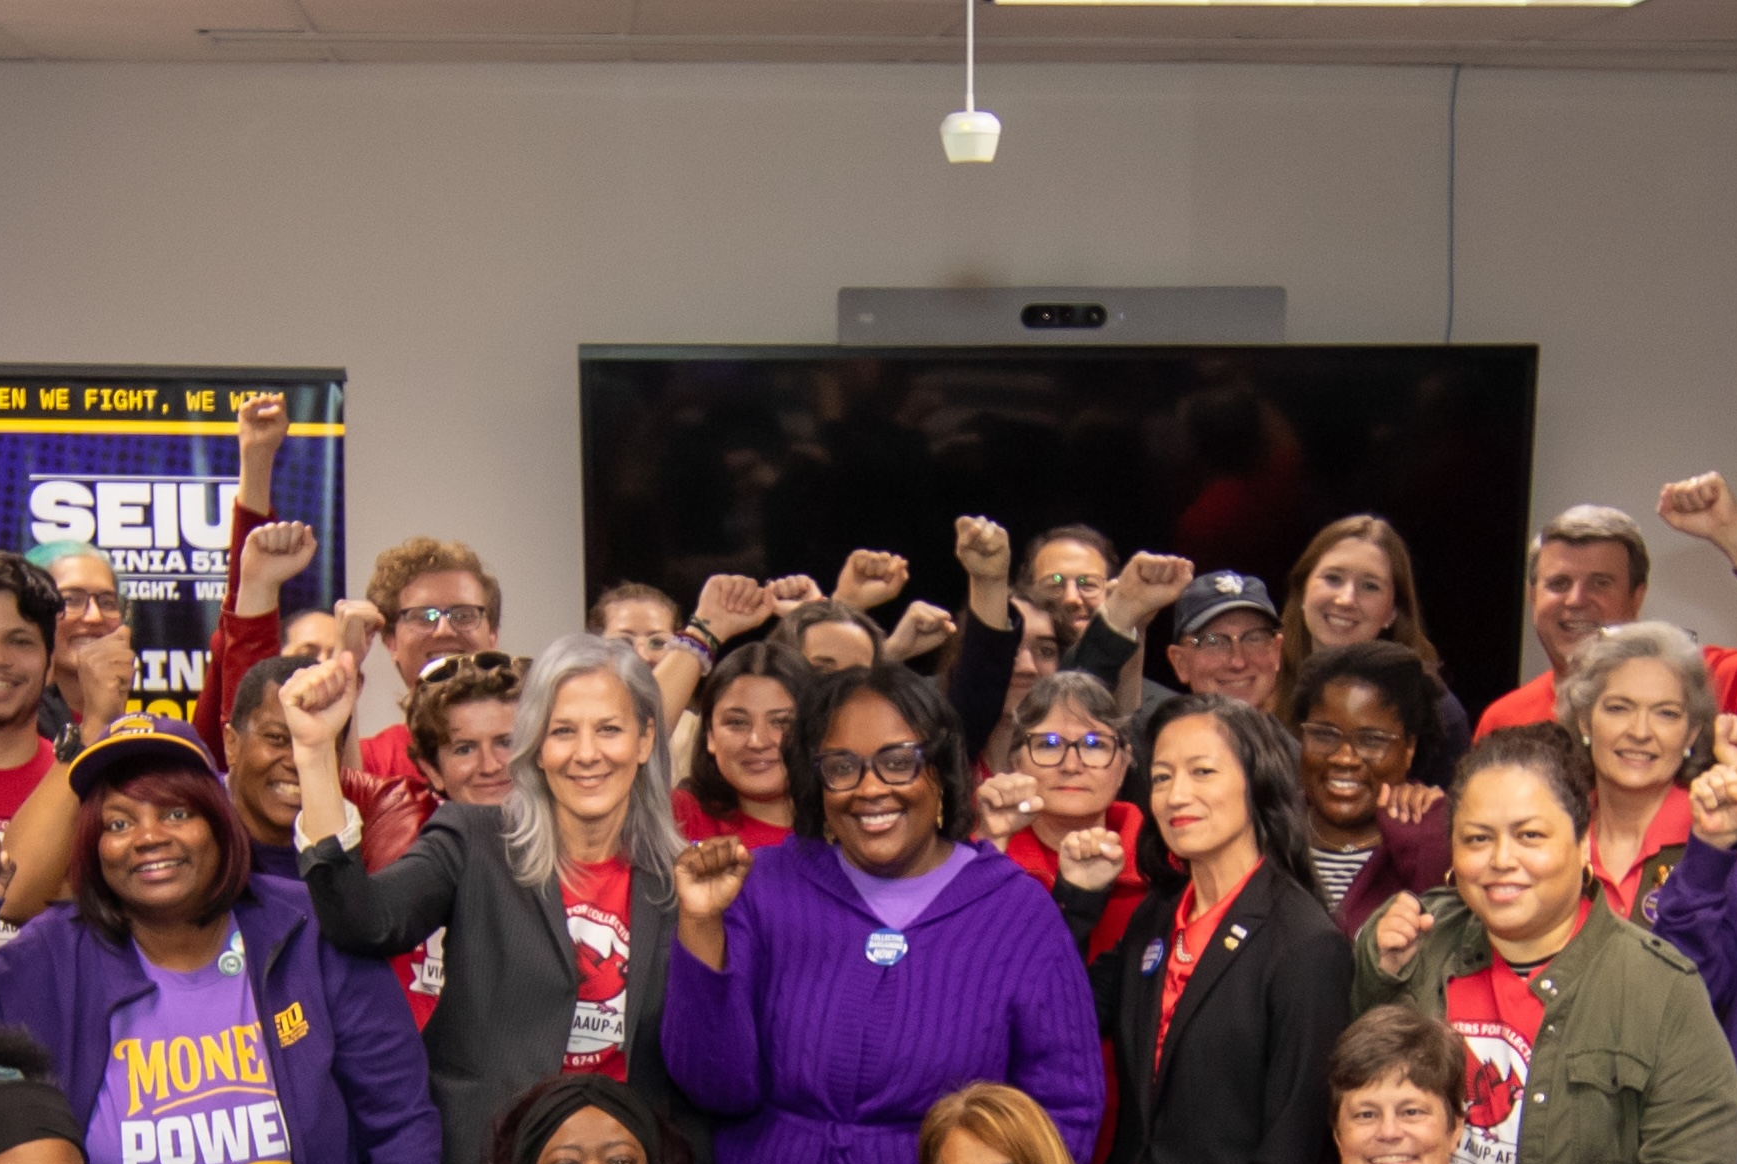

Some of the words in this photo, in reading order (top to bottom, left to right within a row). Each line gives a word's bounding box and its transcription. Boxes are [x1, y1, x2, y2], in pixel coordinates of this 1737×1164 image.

[40, 388, 69, 410] WE
[84, 388, 170, 415] FIGHT,
[186, 389, 215, 412] WE
[29, 480, 240, 549] SEIU
[111, 550, 187, 573] INIA
[191, 550, 231, 573] 51
[194, 580, 229, 601] WI
[572, 1014, 623, 1035] AAUP-A
[113, 1021, 267, 1117] MONE
[571, 1053, 601, 1067] 6741
